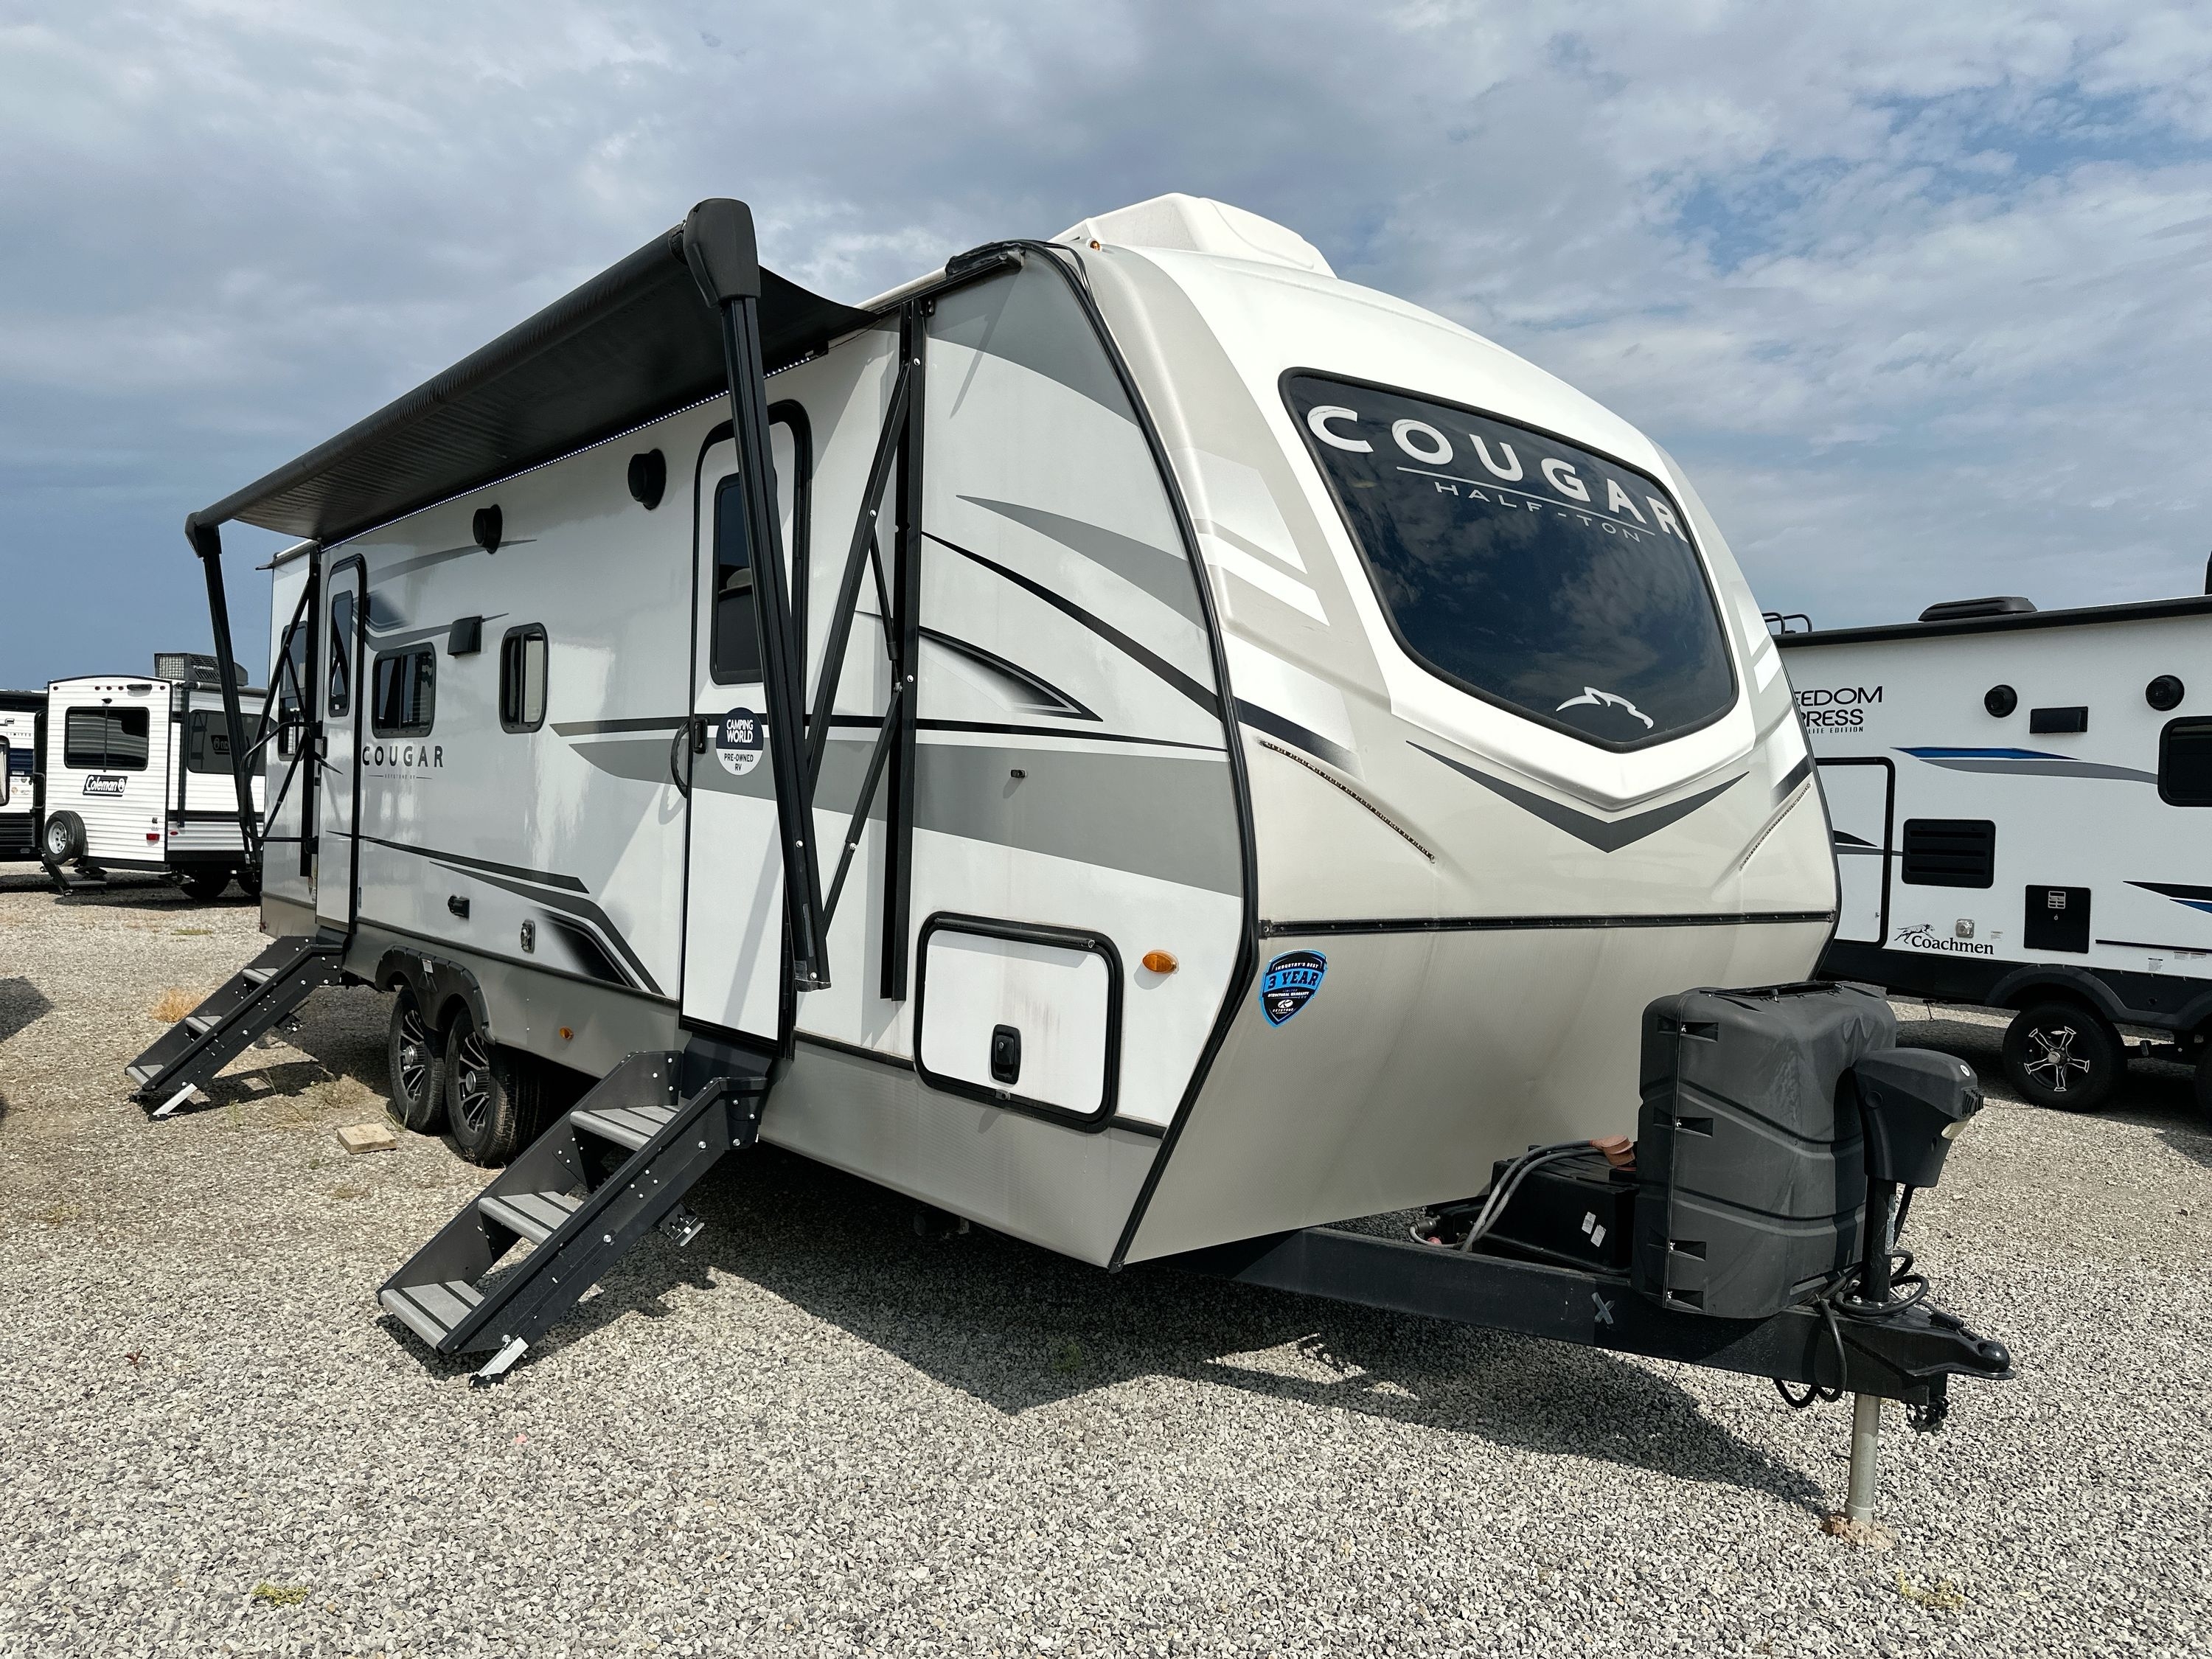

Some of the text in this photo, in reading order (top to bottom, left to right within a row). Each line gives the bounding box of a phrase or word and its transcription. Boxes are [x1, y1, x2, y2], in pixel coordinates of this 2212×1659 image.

[1307, 405, 1688, 543] COUGAR
[1434, 481, 1641, 543] HALF-TON
[726, 719, 754, 731] CAMPING
[1801, 709, 1864, 727] RESS
[726, 729, 754, 743] WORLD
[362, 745, 444, 768] COUGAR
[724, 753, 754, 762] PRE-OWNED
[734, 763, 742, 771] RV
[86, 776, 118, 792] Coleman
[1911, 936, 1994, 955] Coachmen
[1268, 970, 1320, 989] 3 YEAR
